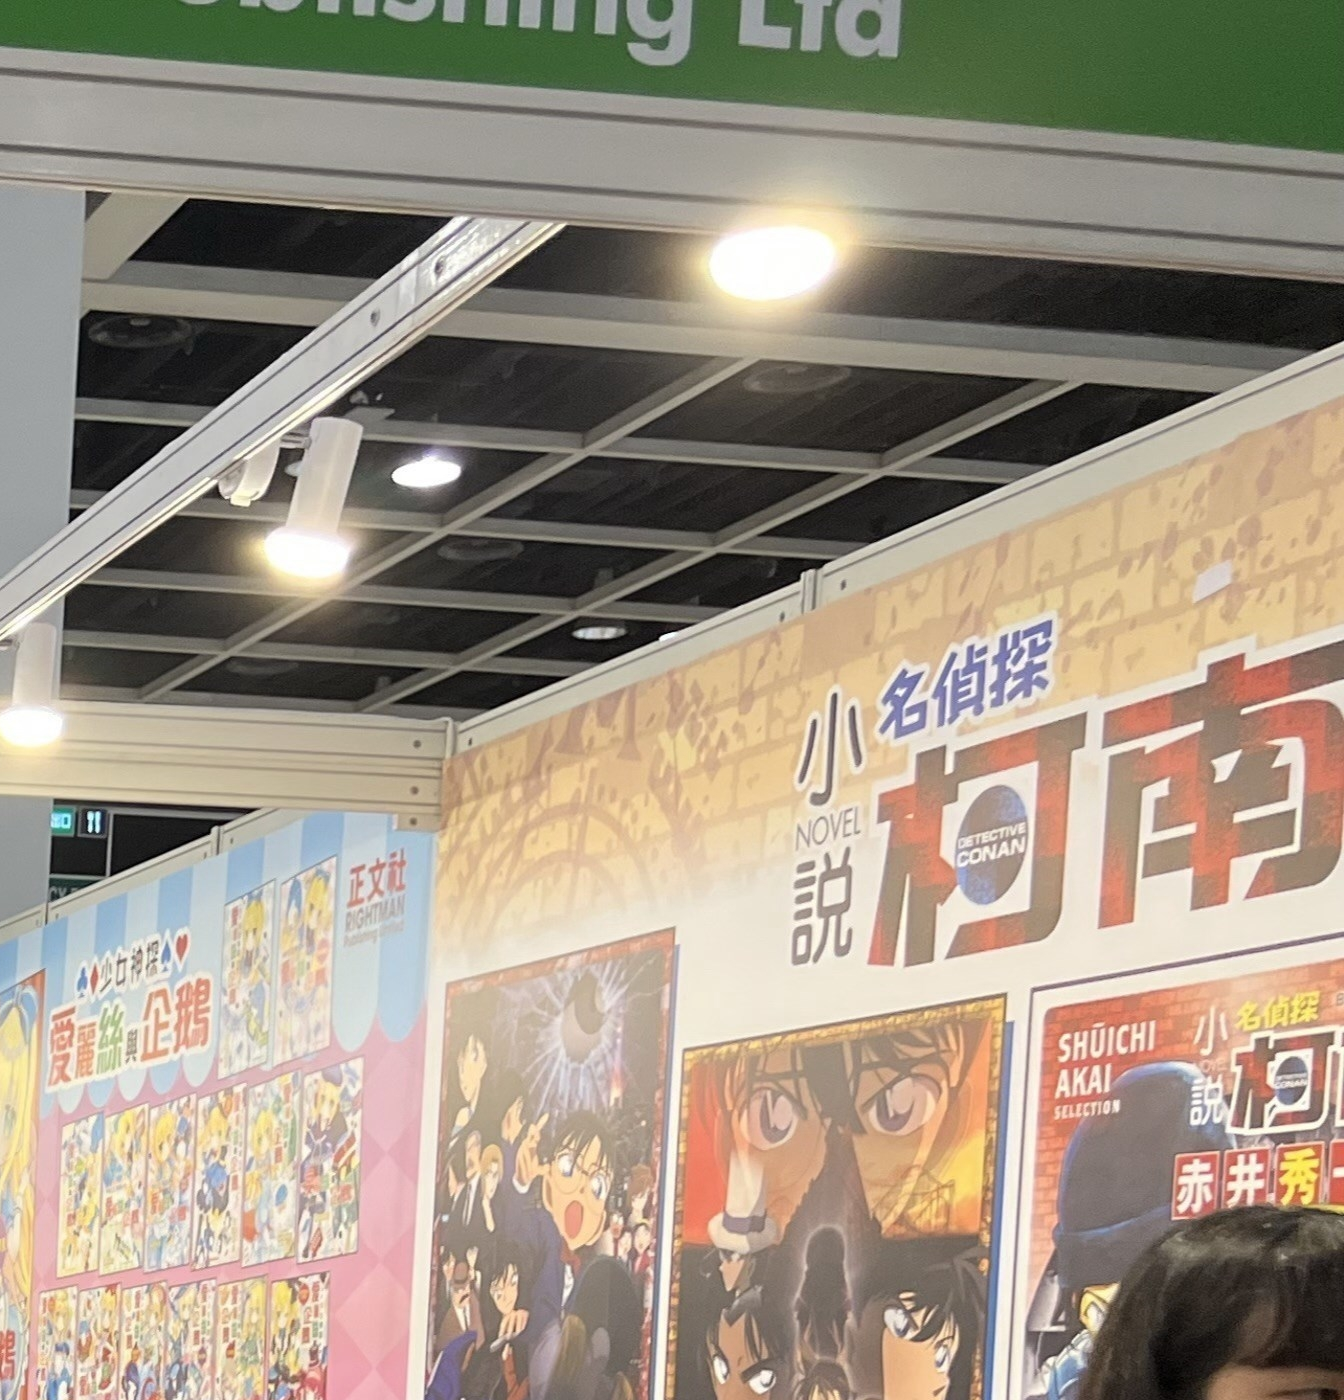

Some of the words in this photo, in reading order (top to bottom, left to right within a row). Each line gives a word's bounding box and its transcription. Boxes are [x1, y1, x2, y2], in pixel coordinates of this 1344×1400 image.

[737, 0, 900, 58] Ltd
[878, 617, 1054, 741] 名偵探
[794, 690, 865, 807] 小
[794, 806, 862, 851] NOVEL
[867, 639, 1344, 969] 柯南
[956, 837, 1027, 868] CONAN
[957, 821, 1027, 850] DETECTIVE
[346, 848, 407, 909] 正文社
[345, 896, 405, 934] RIGHTMAN
[99, 940, 160, 993] 少女神探
[47, 977, 211, 1087] 愛麗絲與企鵝
[1193, 1006, 1229, 1056] 小
[1233, 990, 1320, 1032] 名偵探
[1054, 1062, 1113, 1100] AKAI
[1053, 1099, 1121, 1121] SELECTION
